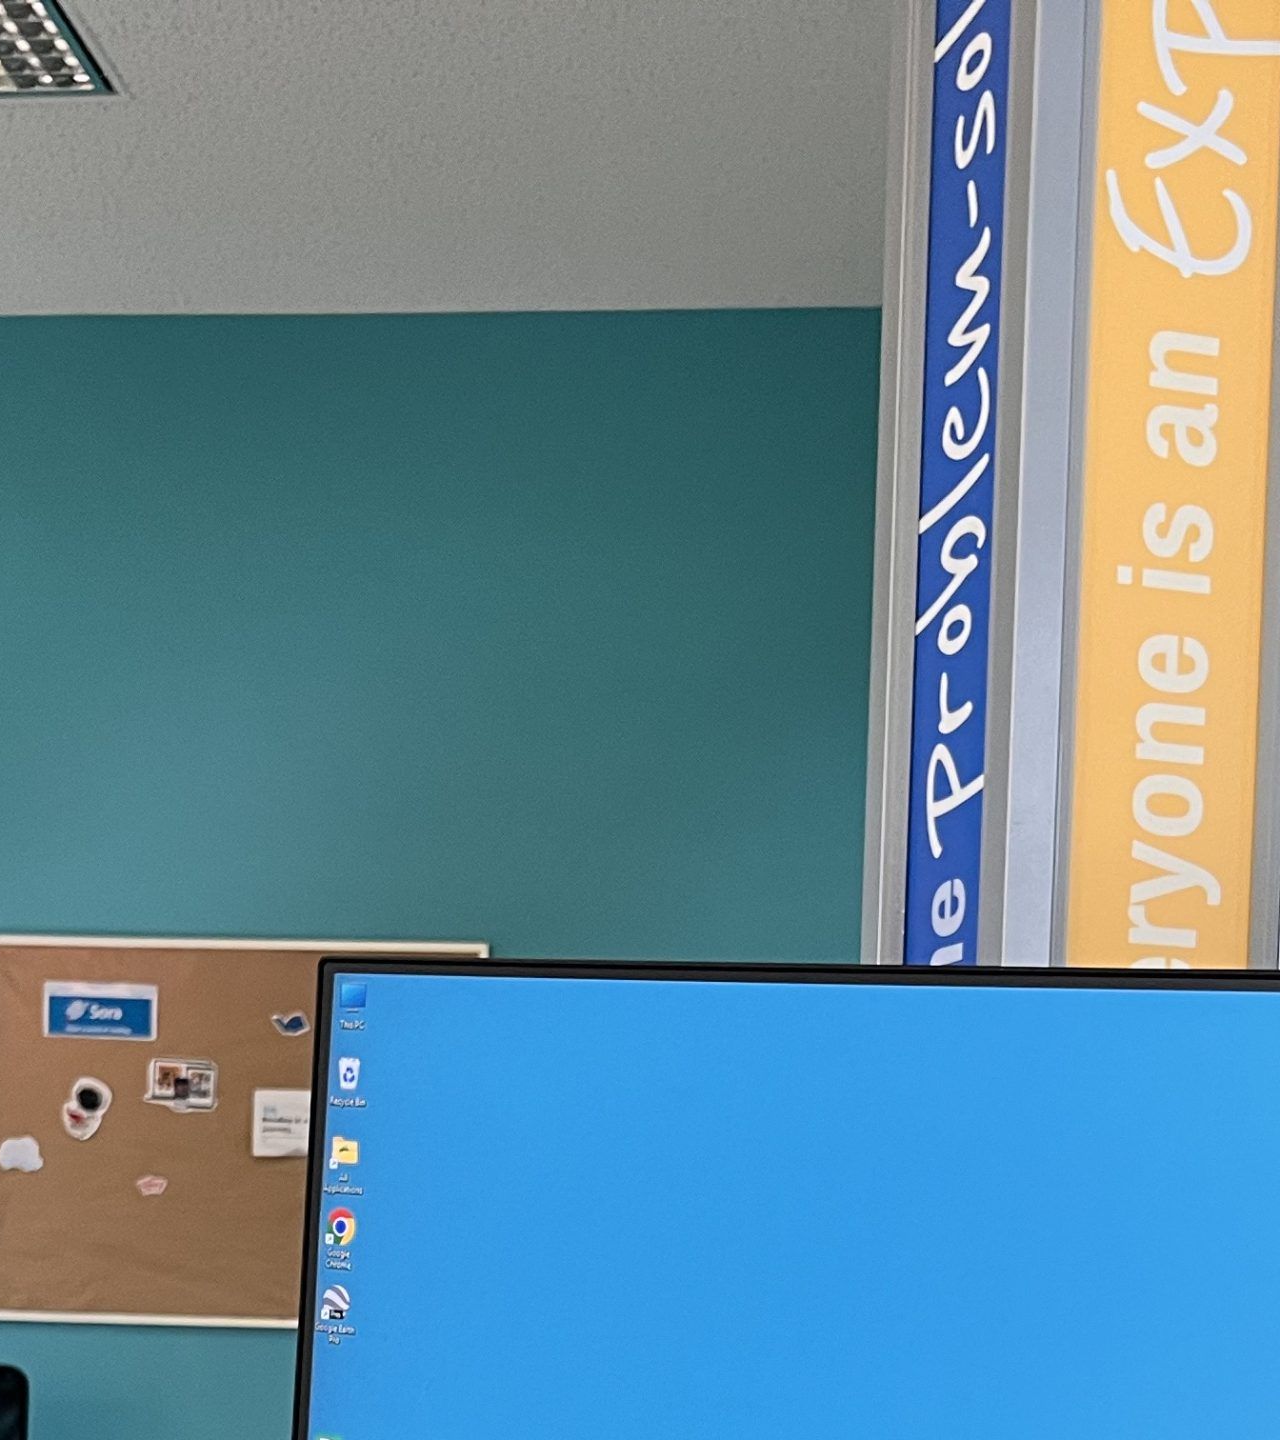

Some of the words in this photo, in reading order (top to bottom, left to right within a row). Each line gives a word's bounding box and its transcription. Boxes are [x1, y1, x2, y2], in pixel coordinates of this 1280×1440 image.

[1145, 329, 1221, 468] an
[1116, 501, 1215, 594] is
[1126, 632, 1221, 969] ryone
